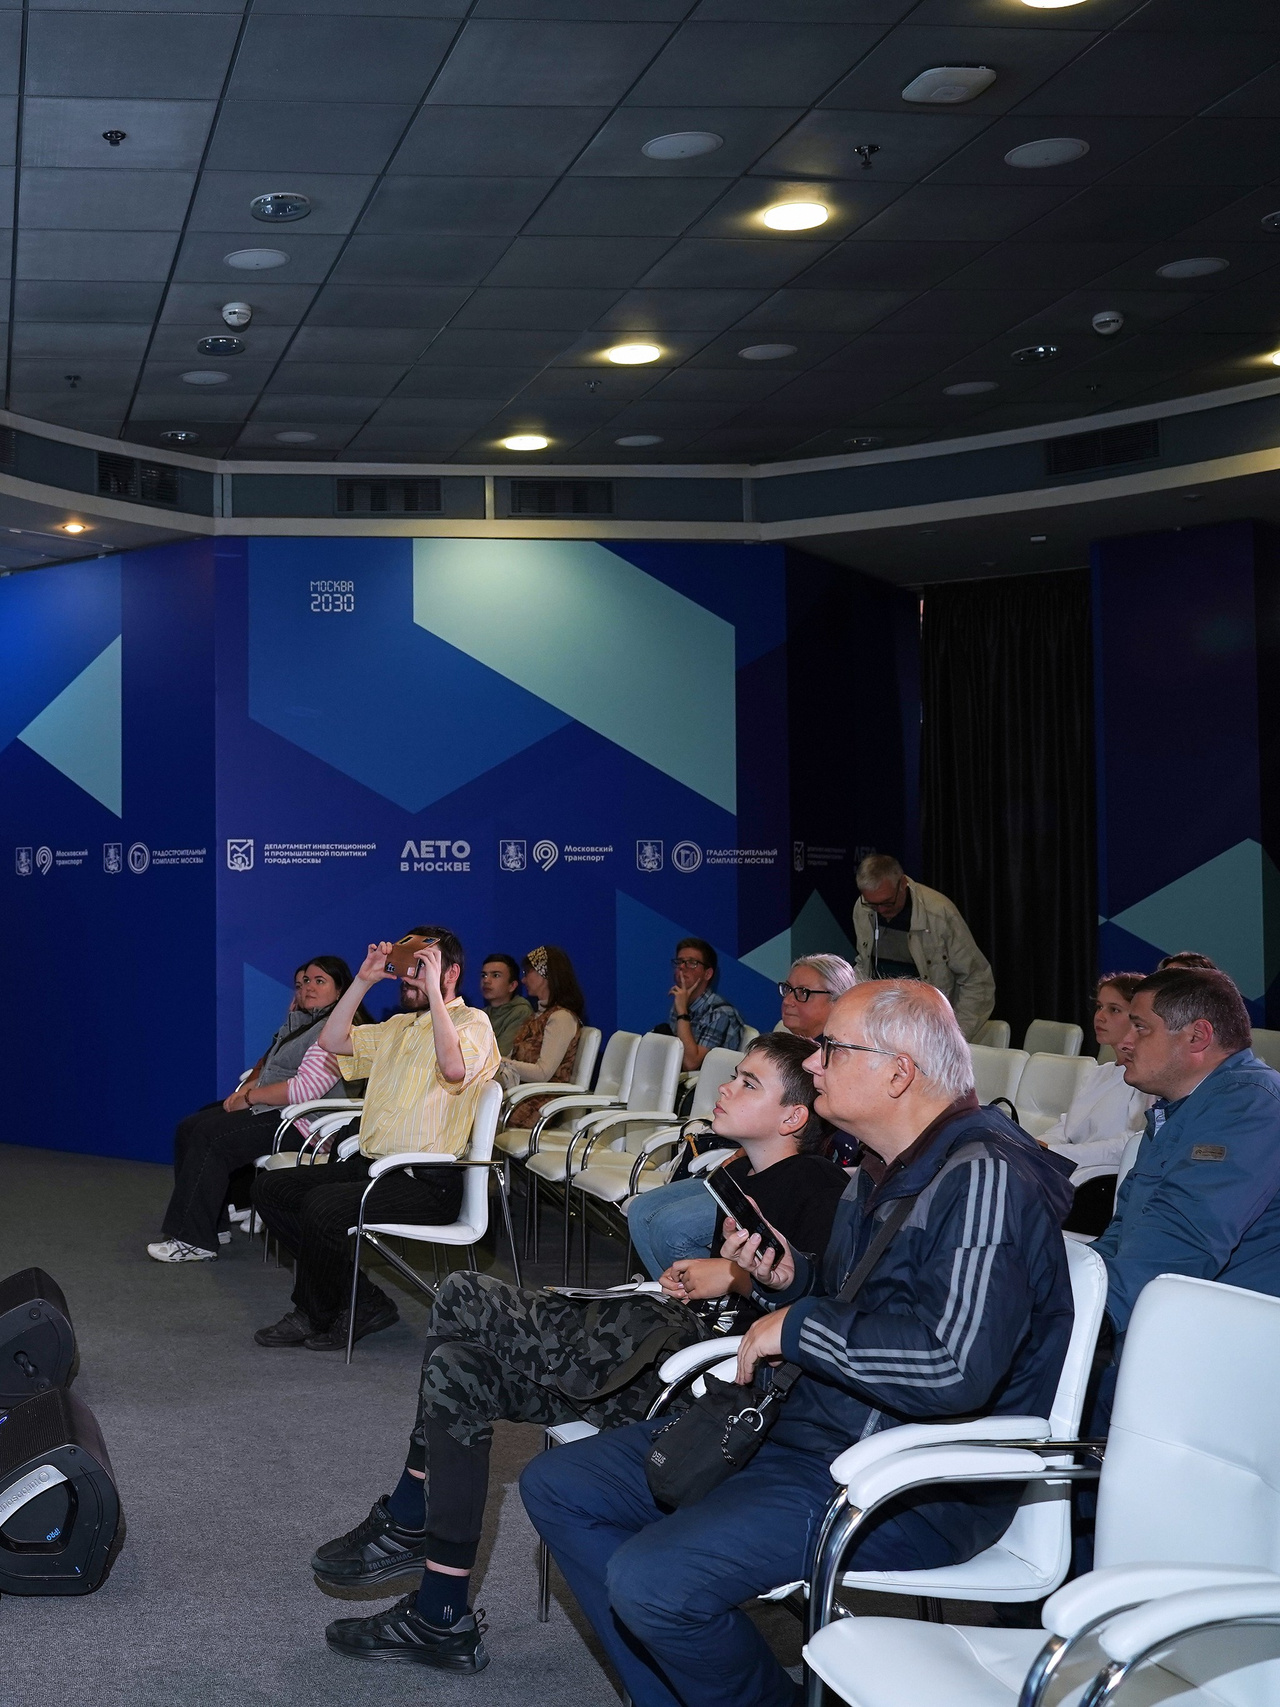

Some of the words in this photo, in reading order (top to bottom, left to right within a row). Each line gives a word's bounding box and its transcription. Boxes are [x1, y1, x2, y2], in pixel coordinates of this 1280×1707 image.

[310, 580, 355, 592] МОСКВА
[310, 593, 355, 612] 2030
[312, 842, 377, 850] ИНВЕСТИЦИОННОЙ
[401, 840, 471, 859] ЛЕТО
[564, 844, 614, 853] Московский
[55, 848, 89, 857] Московский
[152, 848, 207, 857] ГРАДОСТРОИТЕЛЬНЫЙ
[706, 848, 778, 857] ГРАДОСТРОИТЕЛЬНЫЙ
[152, 857, 180, 865] КОМПЛЕКС
[564, 855, 605, 863] транспорт
[706, 857, 743, 865] КОМПЛЕКС
[744, 857, 775, 865] МОСКВЫ
[400, 861, 410, 872] В
[413, 861, 471, 872] МОСКВЕ
